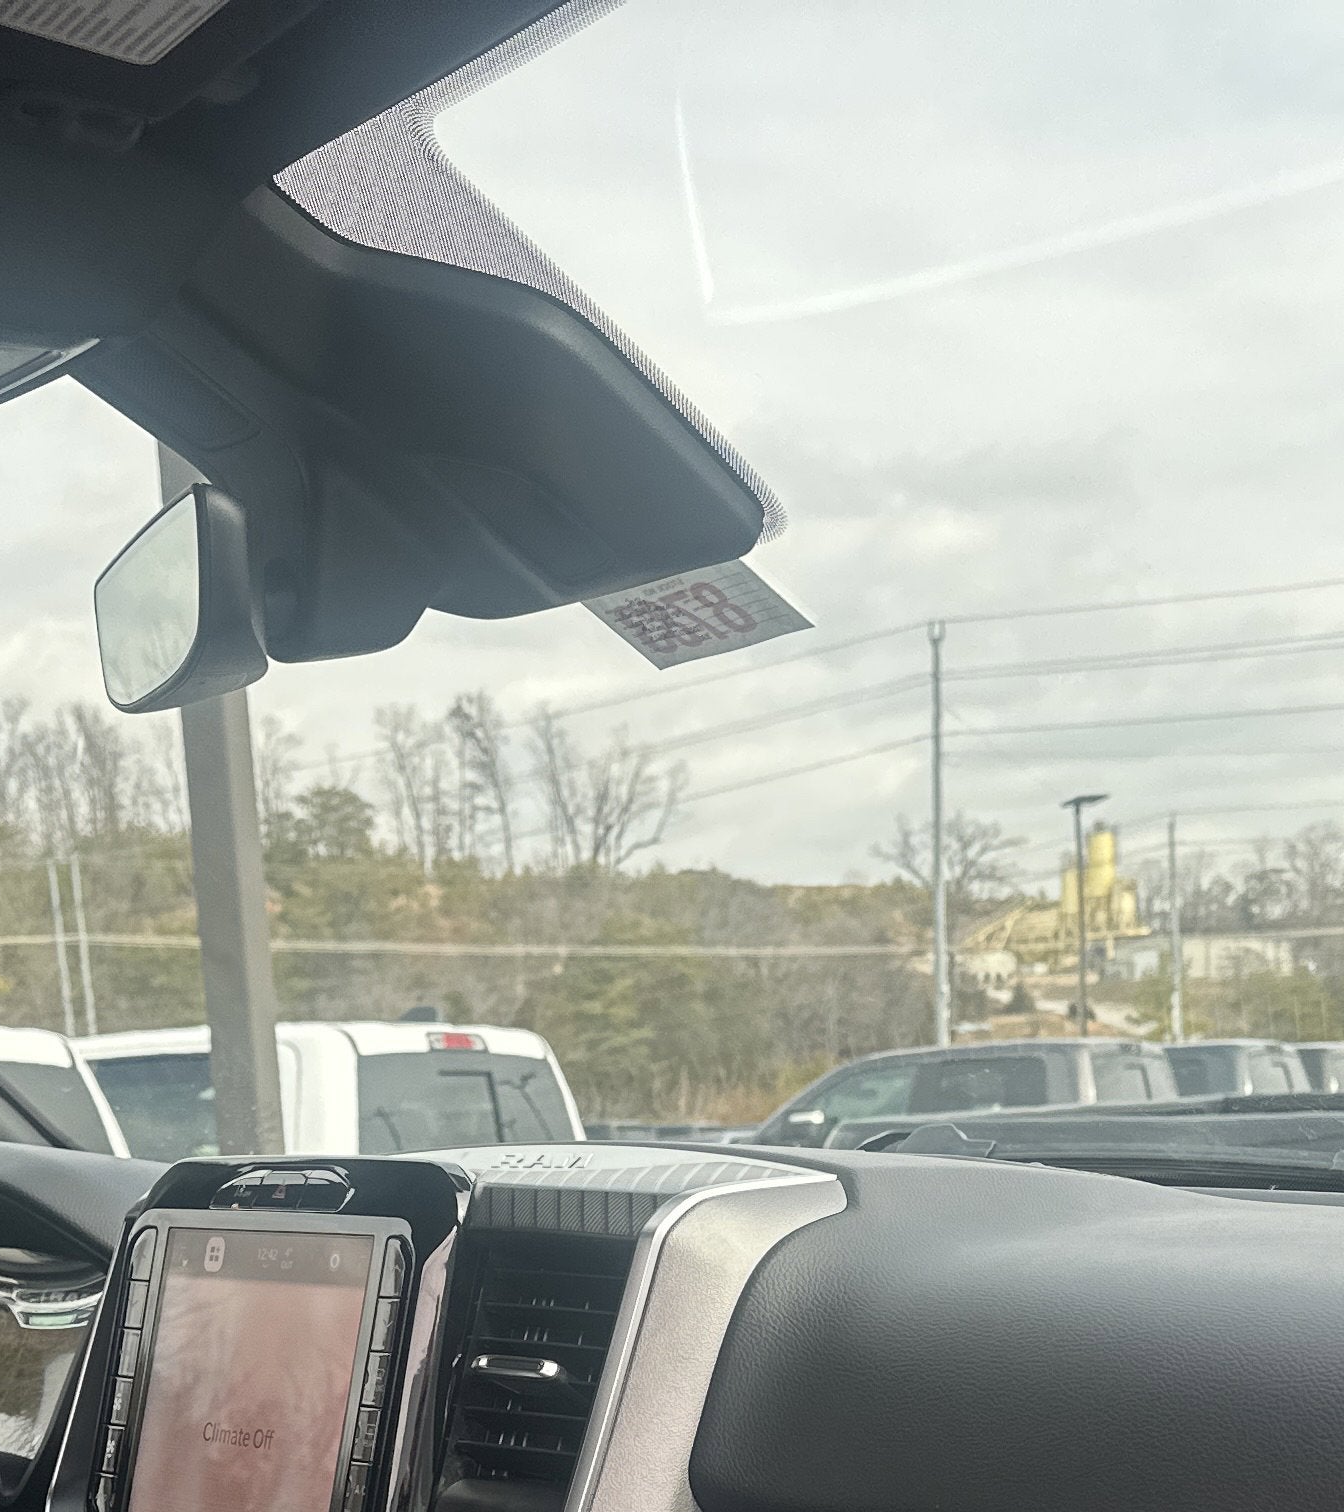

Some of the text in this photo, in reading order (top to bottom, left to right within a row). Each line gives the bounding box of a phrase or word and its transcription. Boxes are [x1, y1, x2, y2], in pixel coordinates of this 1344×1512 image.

[491, 1153, 594, 1168] RAM
[203, 1422, 275, 1450] Climate Off
